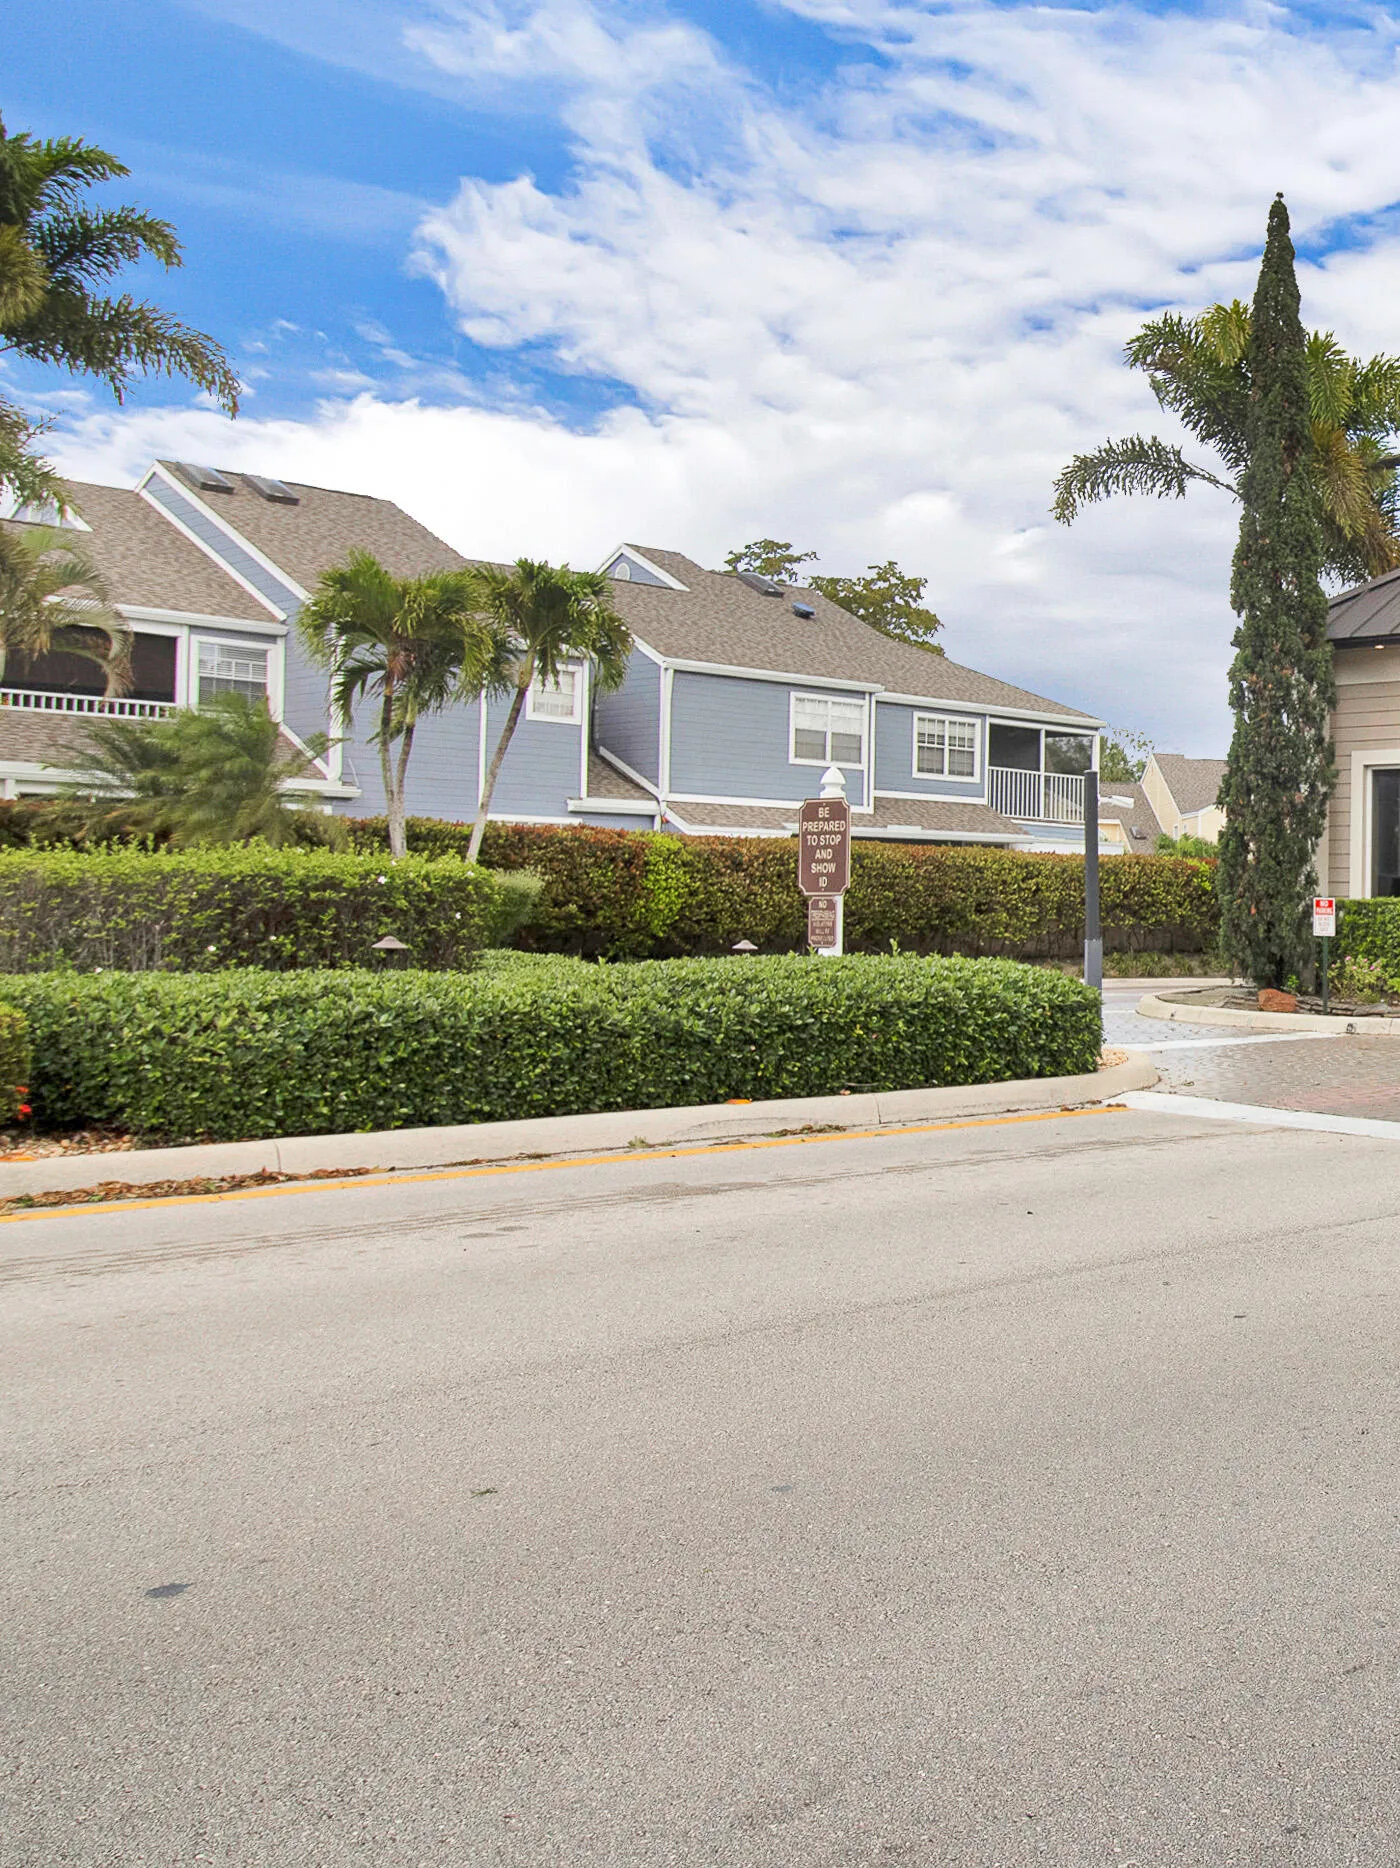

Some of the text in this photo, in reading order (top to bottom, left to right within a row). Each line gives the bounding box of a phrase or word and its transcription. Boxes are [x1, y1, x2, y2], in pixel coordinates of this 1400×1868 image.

[818, 807, 830, 818] BE
[802, 821, 846, 832] PREPARED
[807, 835, 841, 846] TO STOP
[815, 848, 833, 860] AND
[811, 862, 836, 874] SHOW
[819, 876, 828, 887] ID
[819, 900, 827, 908] NO
